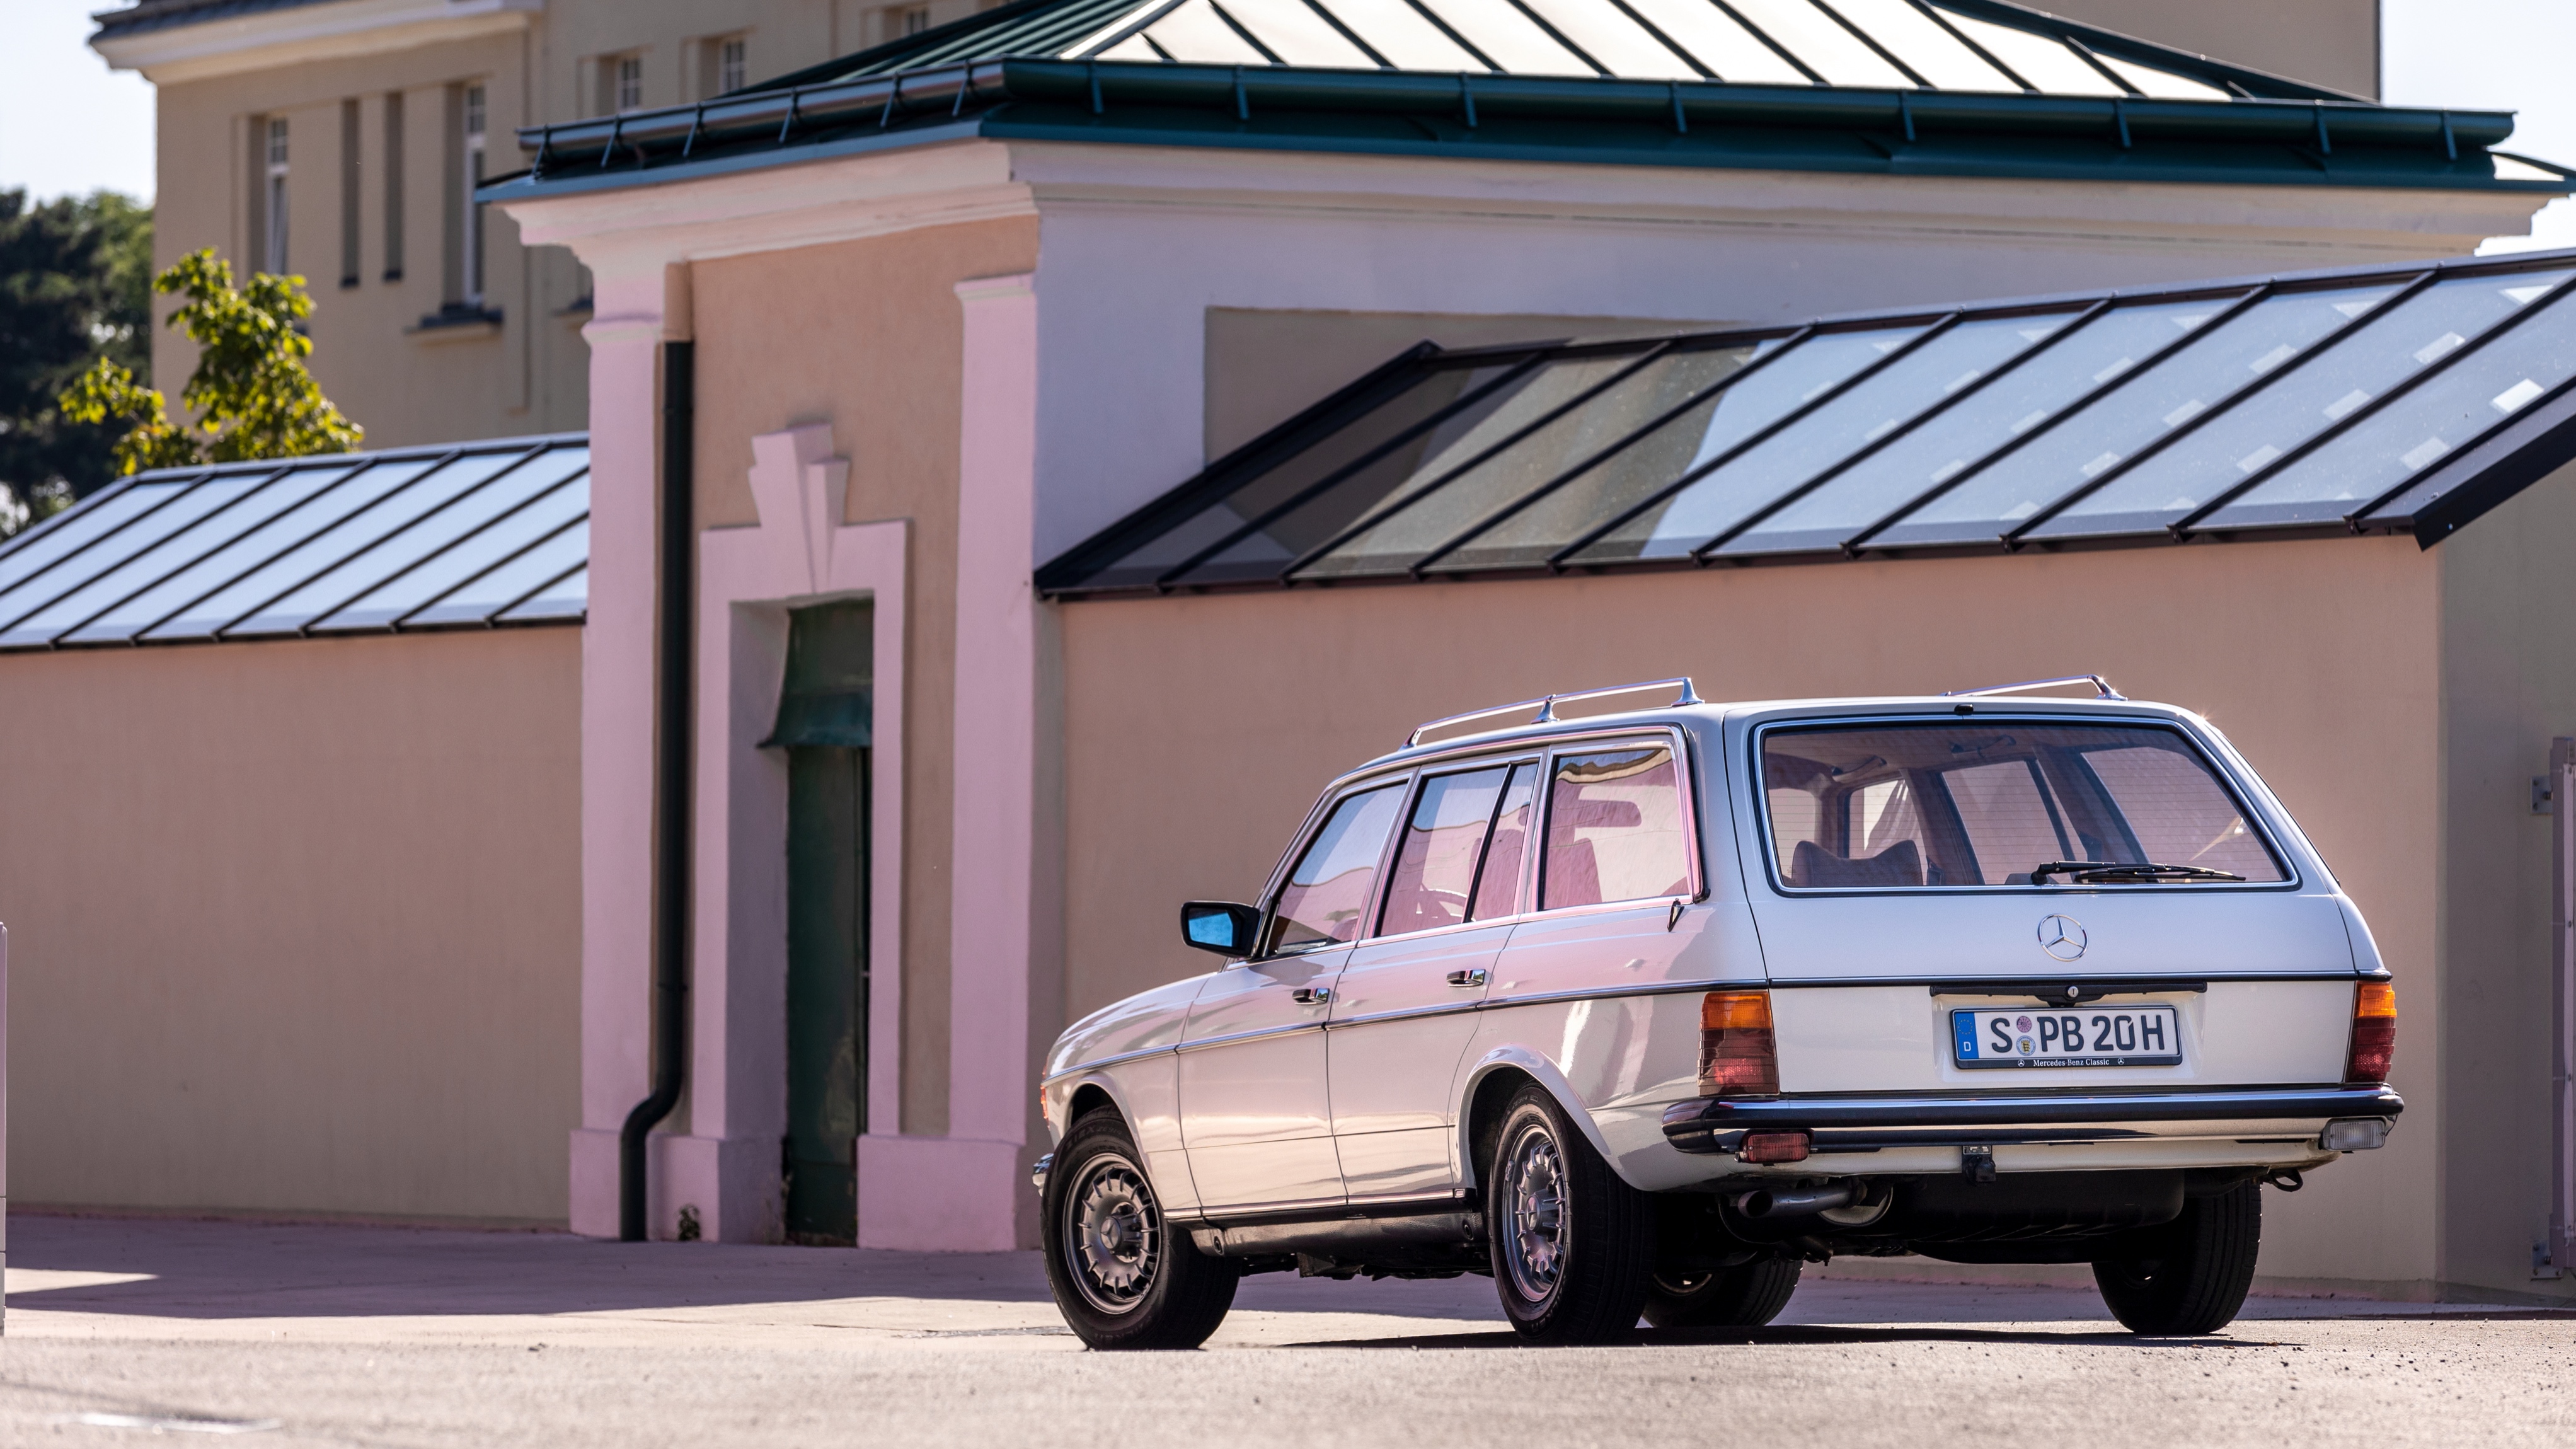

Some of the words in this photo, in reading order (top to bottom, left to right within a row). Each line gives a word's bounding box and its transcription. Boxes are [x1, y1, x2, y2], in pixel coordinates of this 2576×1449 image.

[1991, 1018, 2013, 1053] S
[2037, 1016, 2084, 1052] PB
[1964, 1041, 1972, 1052] D
[2033, 1059, 2084, 1067] Mercedes-Benz
